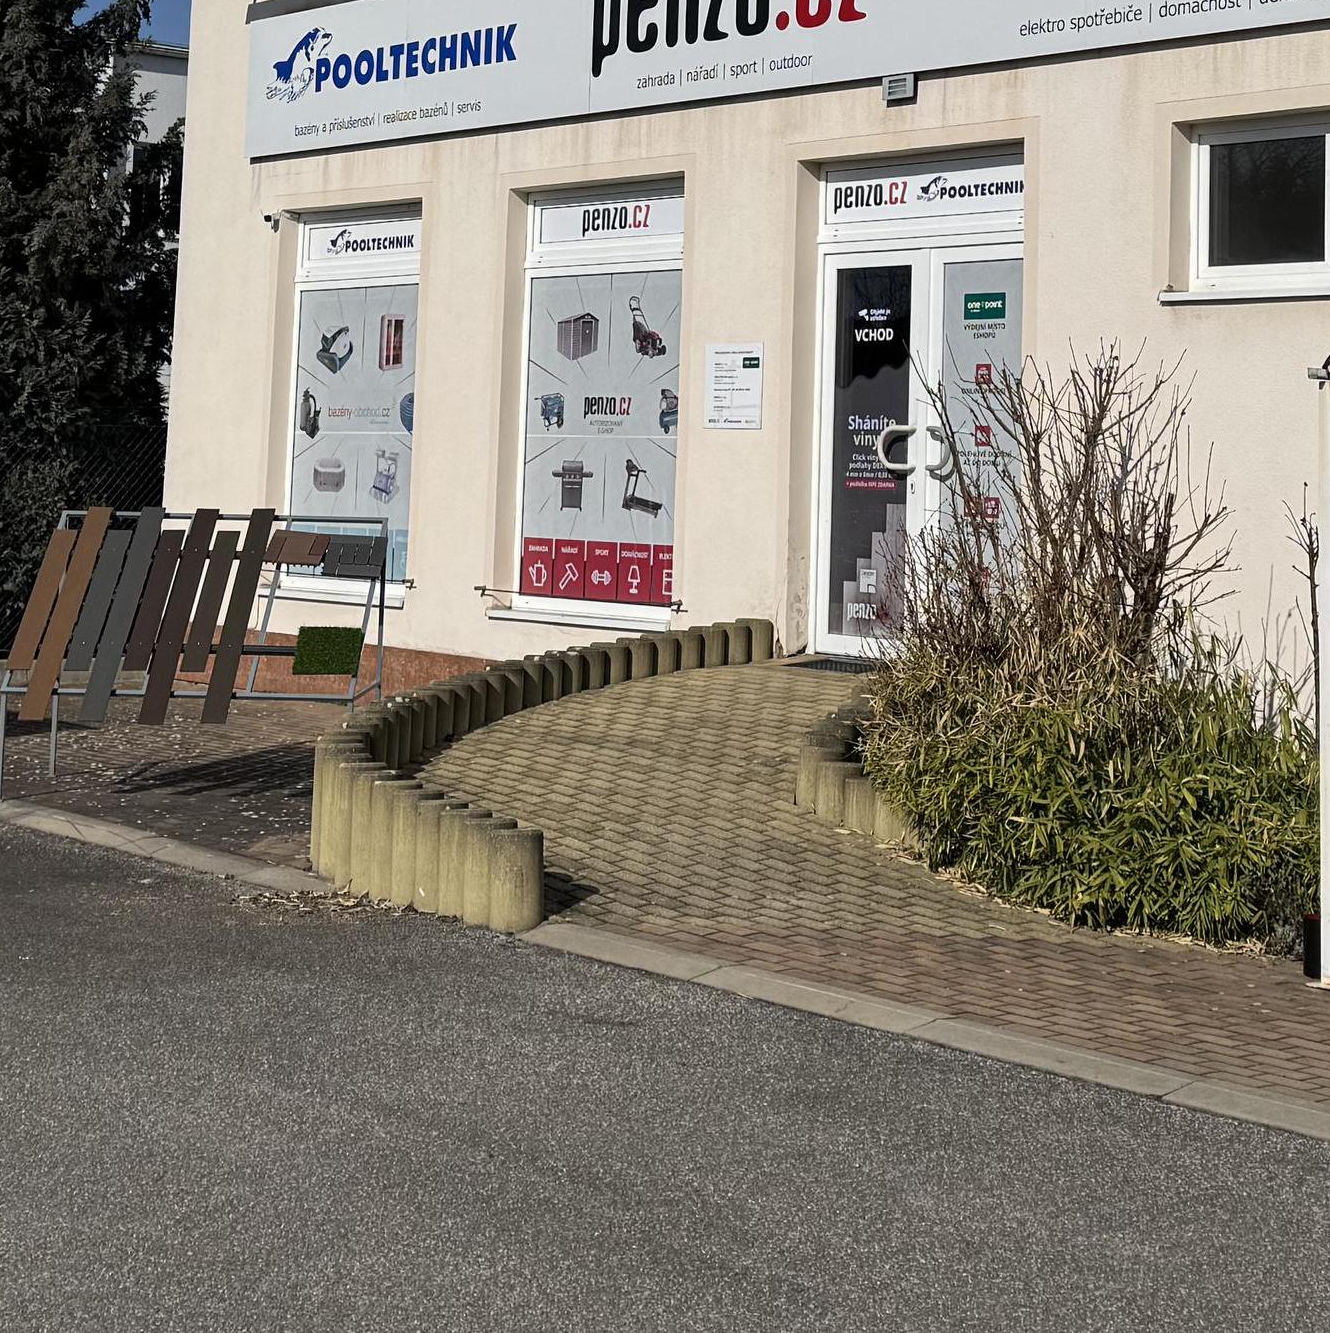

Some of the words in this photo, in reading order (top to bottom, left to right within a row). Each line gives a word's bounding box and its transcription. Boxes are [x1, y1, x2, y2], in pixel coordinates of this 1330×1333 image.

[1020, 17, 1065, 37] elektro
[1070, 5, 1142, 33] spotřebiče
[314, 23, 518, 93] POOLTECHNIK
[637, 71, 675, 90] zahrada
[686, 63, 718, 83] nářadí
[730, 60, 757, 79] sport
[769, 53, 812, 72] outdoor
[295, 120, 319, 137] bazény
[322, 123, 327, 133] a
[329, 113, 375, 135] příslušenství
[383, 109, 417, 124] realizace
[420, 102, 448, 118] bazénů
[457, 100, 481, 114] servis
[834, 181, 908, 215] penzo.cz
[582, 204, 651, 238] penzo.cz
[345, 234, 415, 253] POOLTECHNIK
[855, 328, 894, 342] VCHOD
[584, 397, 631, 420] penzo.cz
[848, 415, 896, 430] Sháníte
[853, 431, 879, 450] viny
